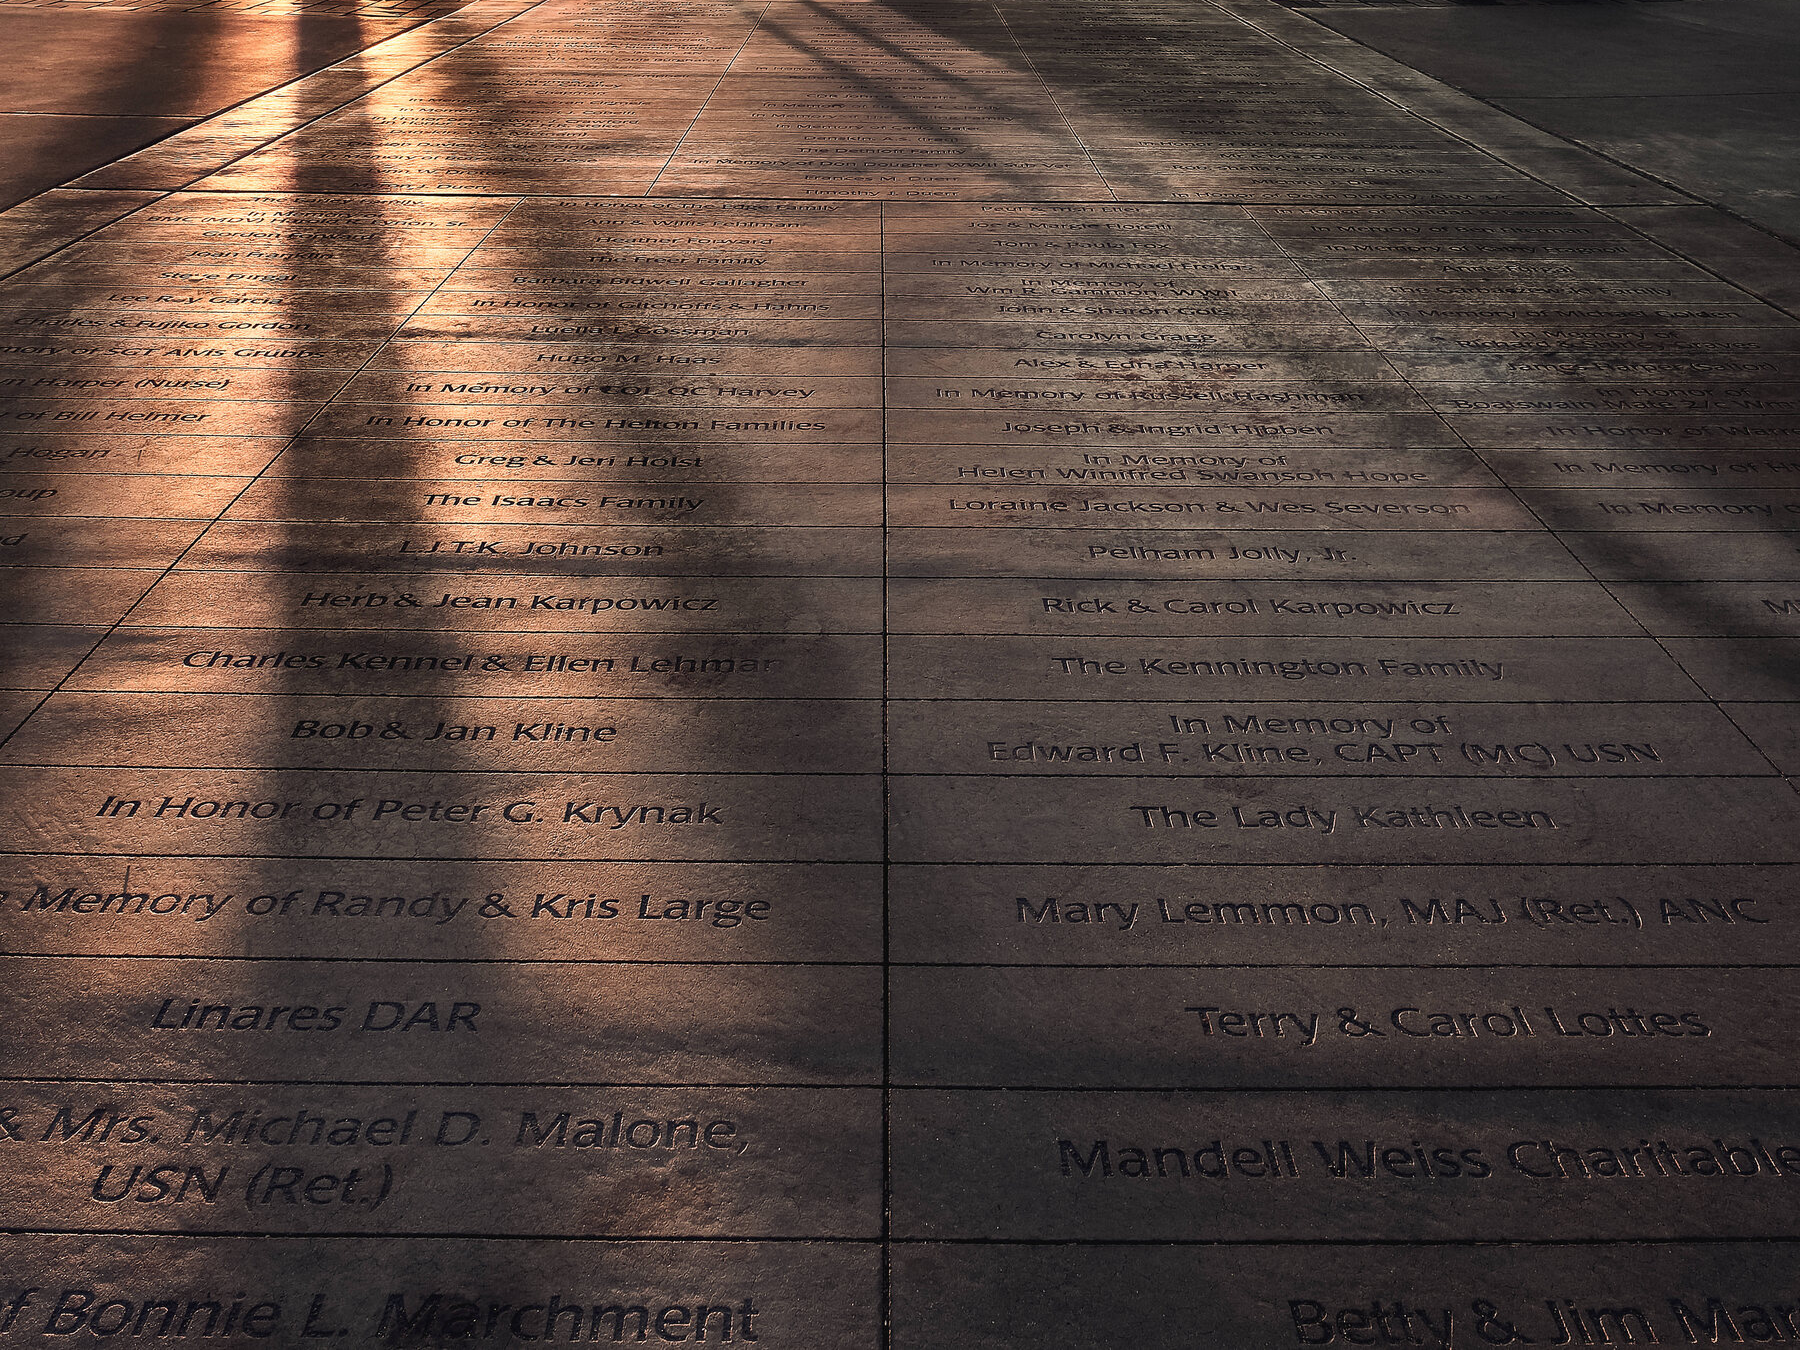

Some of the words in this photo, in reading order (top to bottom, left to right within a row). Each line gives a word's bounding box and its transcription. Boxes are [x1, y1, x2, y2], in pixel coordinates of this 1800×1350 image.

[634, 256, 689, 265] Freer
[512, 277, 602, 285] Barbara
[609, 278, 692, 286] Bidwell
[107, 294, 148, 302] Lee
[1035, 331, 1132, 341] Carolyn
[32, 376, 127, 390] Harper
[134, 378, 232, 392] (Nurse)
[406, 382, 432, 393] In
[439, 383, 557, 396] Memory
[563, 384, 594, 395] of
[716, 387, 816, 399] Harvey
[1620, 388, 1716, 398] Honor
[935, 389, 962, 399] In
[970, 389, 1087, 402] Memory
[1094, 390, 1123, 400] of
[16, 410, 53, 421] of
[52, 410, 98, 422] Bill
[104, 411, 212, 424] Helmer
[365, 415, 394, 426] In
[402, 416, 496, 429] Honor
[502, 417, 542, 429] of
[541, 418, 596, 429] The
[710, 420, 827, 433] Families
[1001, 422, 1101, 436] Joseph
[1108, 423, 1137, 435] &
[1137, 424, 1223, 437] Ingrid
[1581, 426, 1675, 439] Honor
[7, 447, 111, 461] Hogan
[454, 454, 528, 467] Greg
[531, 455, 561, 466] &
[563, 455, 616, 467] Jeri
[626, 456, 705, 468] Holst
[1083, 454, 1112, 466] In
[1120, 454, 1248, 469] Memory
[1257, 455, 1289, 466] of
[956, 466, 1048, 480] Helen
[1344, 472, 1430, 486] Hope
[1552, 463, 1586, 475] In
[1592, 463, 1720, 477] Memory
[422, 494, 480, 506] The
[490, 495, 589, 509] Isaacs
[598, 496, 706, 512] Family
[948, 499, 1069, 512] Loraine
[1075, 499, 1207, 514] Jackson
[1213, 501, 1245, 514] &
[1245, 501, 1318, 515] Wes
[1324, 501, 1471, 519] Severson
[1597, 502, 1632, 516] In
[1640, 503, 1774, 517] Memory
[520, 542, 665, 557] Johnson
[1088, 546, 1216, 561] Pelham
[1319, 548, 1359, 562] Jr.
[299, 593, 389, 607] Herb
[393, 593, 422, 608] &
[433, 593, 524, 610] Jean
[530, 595, 720, 614] Karpowicz
[1041, 597, 1117, 615] Rick
[1126, 598, 1161, 616] &
[1163, 599, 1259, 616] Carol
[1269, 599, 1461, 619] Karpowicz
[181, 651, 323, 670] Charles
[336, 652, 474, 672] Kennel
[480, 654, 516, 673] &
[524, 655, 616, 674] Ellen
[1050, 657, 1129, 677] The
[1138, 657, 1370, 681] Kennington
[1377, 660, 1505, 681] Family
[290, 719, 375, 740] Bob
[379, 721, 415, 741] &
[423, 723, 495, 741] Jan
[511, 723, 619, 743] Kline
[1168, 714, 1212, 736] In
[1222, 714, 1396, 740] Memory
[1408, 715, 1454, 736] of
[986, 741, 1146, 765] Edward
[1158, 742, 1187, 765] F.
[1202, 742, 1323, 767] Kline,
[1333, 743, 1446, 766] CAPT
[1458, 742, 1559, 768] (MC)
[1560, 743, 1665, 764] USN
[95, 796, 140, 819] In
[152, 797, 307, 821] Honor
[311, 798, 365, 821] of
[372, 799, 490, 822] Peter
[502, 801, 545, 824] G.
[562, 801, 725, 831] Krynak
[1130, 804, 1220, 830] The
[1230, 805, 1338, 836] Lady
[1351, 804, 1561, 831] Kathleen
[19, 884, 235, 923] Memory
[244, 889, 305, 918] of
[310, 889, 470, 927] Randy
[476, 892, 519, 920] &
[529, 893, 621, 922] Kris
[636, 893, 773, 930] Large
[1014, 895, 1141, 933] Mary
[1155, 896, 1390, 930] Lemmon,
[1399, 896, 1510, 929] MAJ
[1518, 895, 1645, 931] (Ret.)
[1657, 897, 1771, 929] ANC
[149, 999, 348, 1034] Linares
[359, 999, 484, 1034] DAR
[1183, 1005, 1321, 1049] Terry
[1337, 1006, 1389, 1041] &
[1389, 1005, 1538, 1041] Carol
[1543, 1006, 1714, 1041] Lottes
[37, 1106, 160, 1145] Mrs.
[182, 1109, 419, 1149] Michael
[435, 1110, 492, 1148] D.
[514, 1111, 751, 1157] Malone,
[1057, 1137, 1302, 1181] Mandell
[1310, 1138, 1494, 1181] Weiss
[1506, 1137, 1800, 1181] Charitable
[88, 1164, 232, 1205] USN
[244, 1162, 396, 1213] (Ret.)
[44, 1288, 284, 1342] Bonnie
[300, 1292, 351, 1341] L.
[374, 1291, 761, 1347] Marchment
[1287, 1297, 1455, 1350] Betty
[1471, 1296, 1538, 1348] &
[1542, 1296, 1661, 1348] Jim
